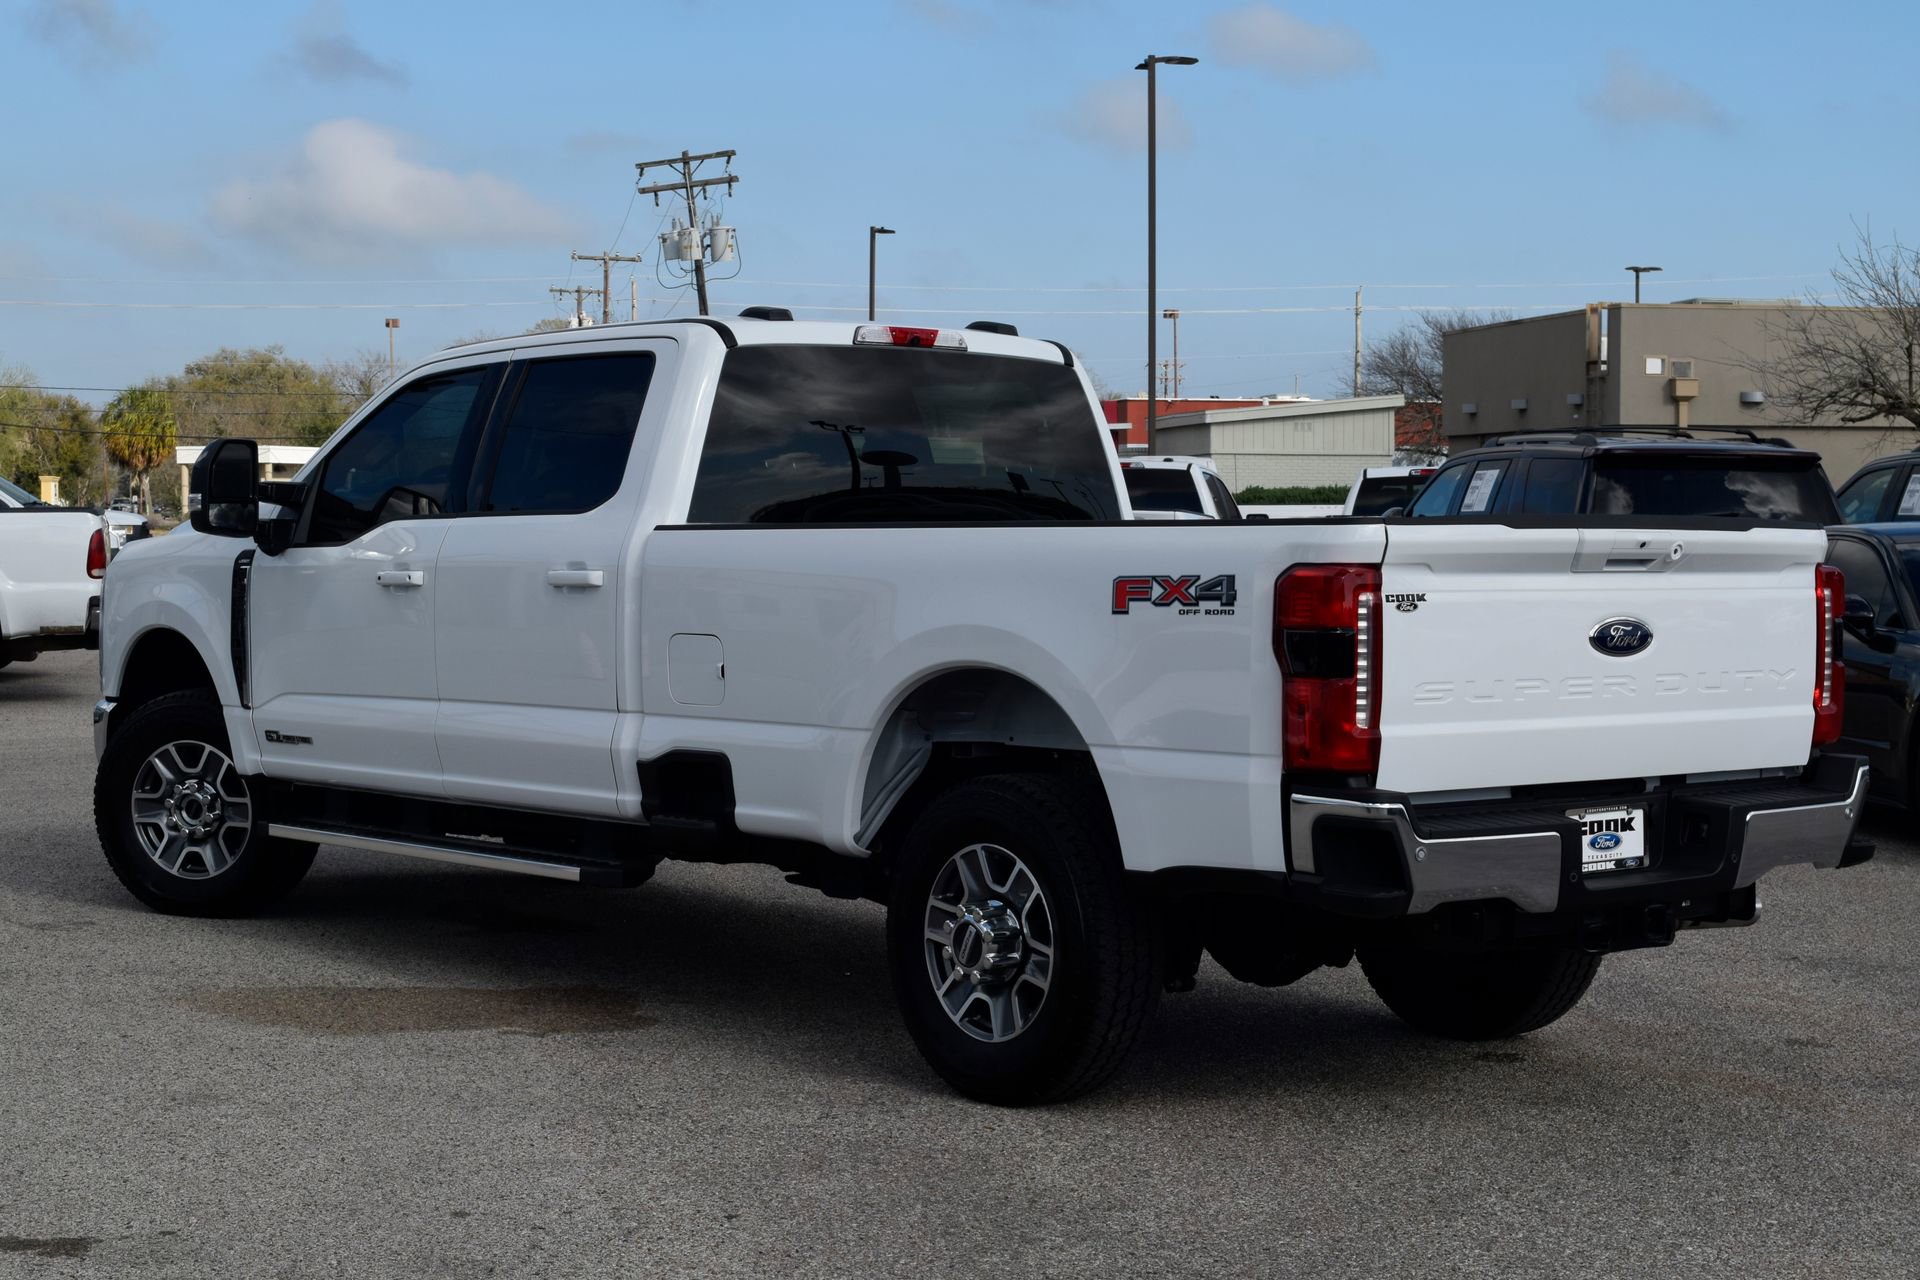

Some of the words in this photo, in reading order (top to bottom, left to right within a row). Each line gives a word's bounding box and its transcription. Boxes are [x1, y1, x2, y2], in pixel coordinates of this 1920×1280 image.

[1112, 574, 1237, 615] FX4
[1385, 593, 1427, 603] COOK
[1178, 608, 1201, 616] OFF
[1204, 608, 1235, 616] ROAD
[1607, 625, 1641, 647] Ford
[1413, 674, 1637, 705] SUPER
[1655, 668, 1797, 696] DUTY
[1595, 835, 1616, 849] Ford
[1582, 861, 1616, 872] COOK
